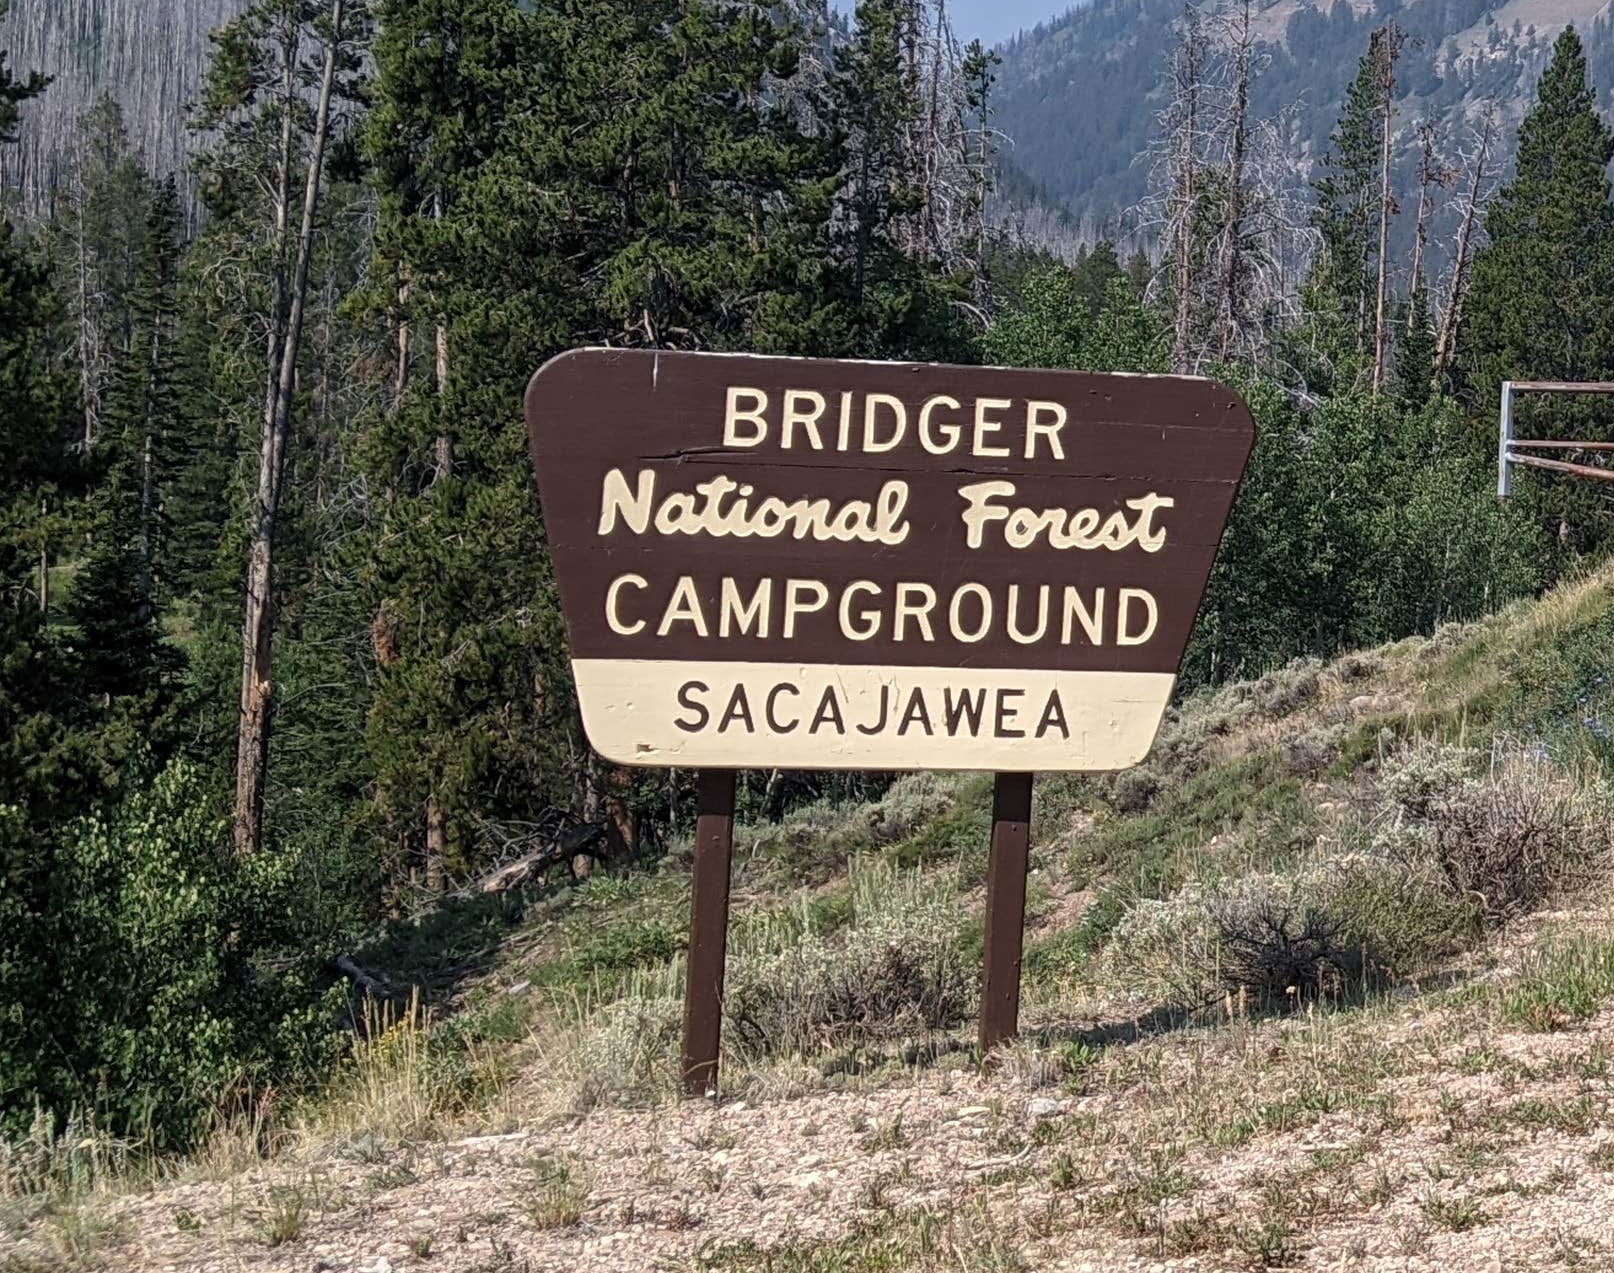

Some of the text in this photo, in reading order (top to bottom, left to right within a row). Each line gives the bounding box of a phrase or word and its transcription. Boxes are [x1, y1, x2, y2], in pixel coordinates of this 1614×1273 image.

[723, 386, 1067, 460] BRIDGER
[597, 468, 1175, 553] National Forest
[604, 573, 1158, 646] CAMPGROUND
[673, 680, 1071, 740] SACAJAWEA
